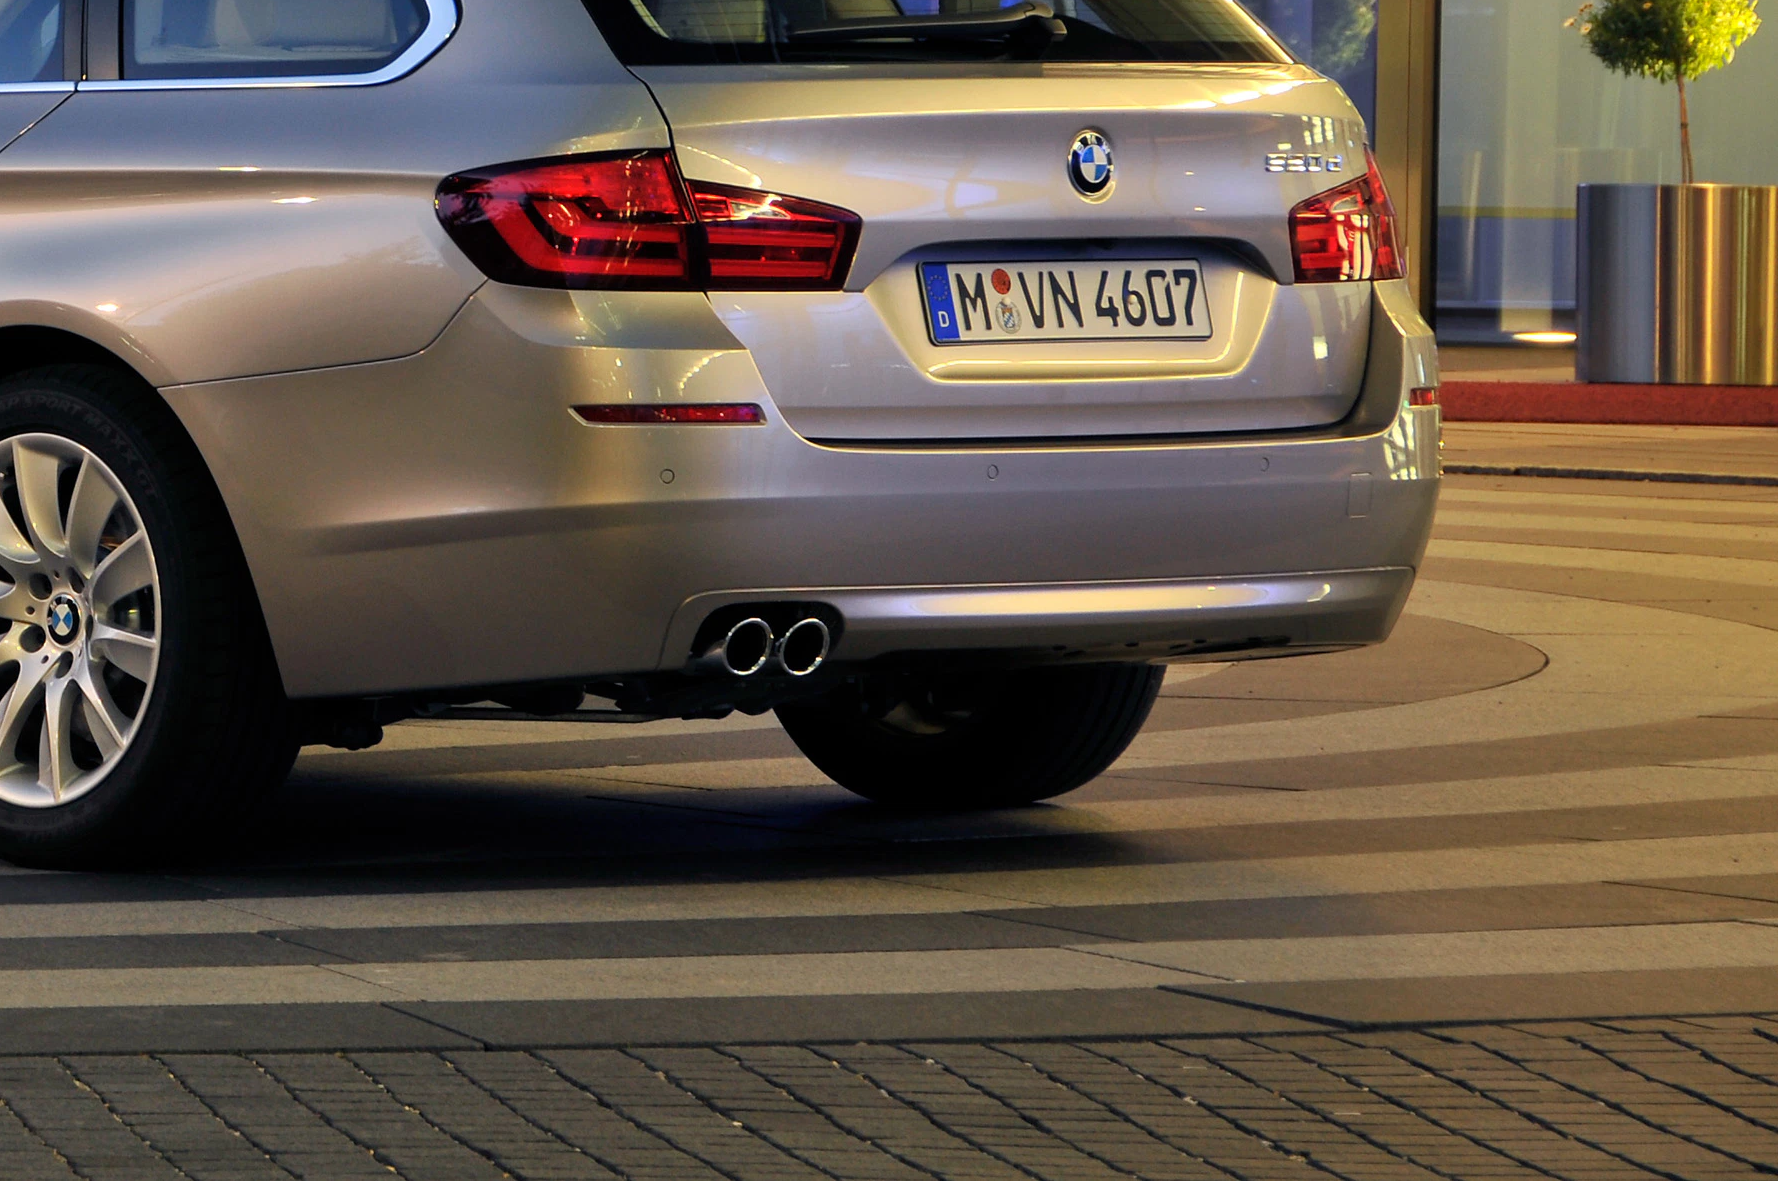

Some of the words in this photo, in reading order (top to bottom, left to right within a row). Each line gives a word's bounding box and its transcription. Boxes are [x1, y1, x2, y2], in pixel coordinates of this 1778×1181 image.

[937, 311, 950, 328] D
[955, 272, 992, 331] M
[1017, 270, 1084, 328] VN
[1095, 269, 1198, 327] 4607
